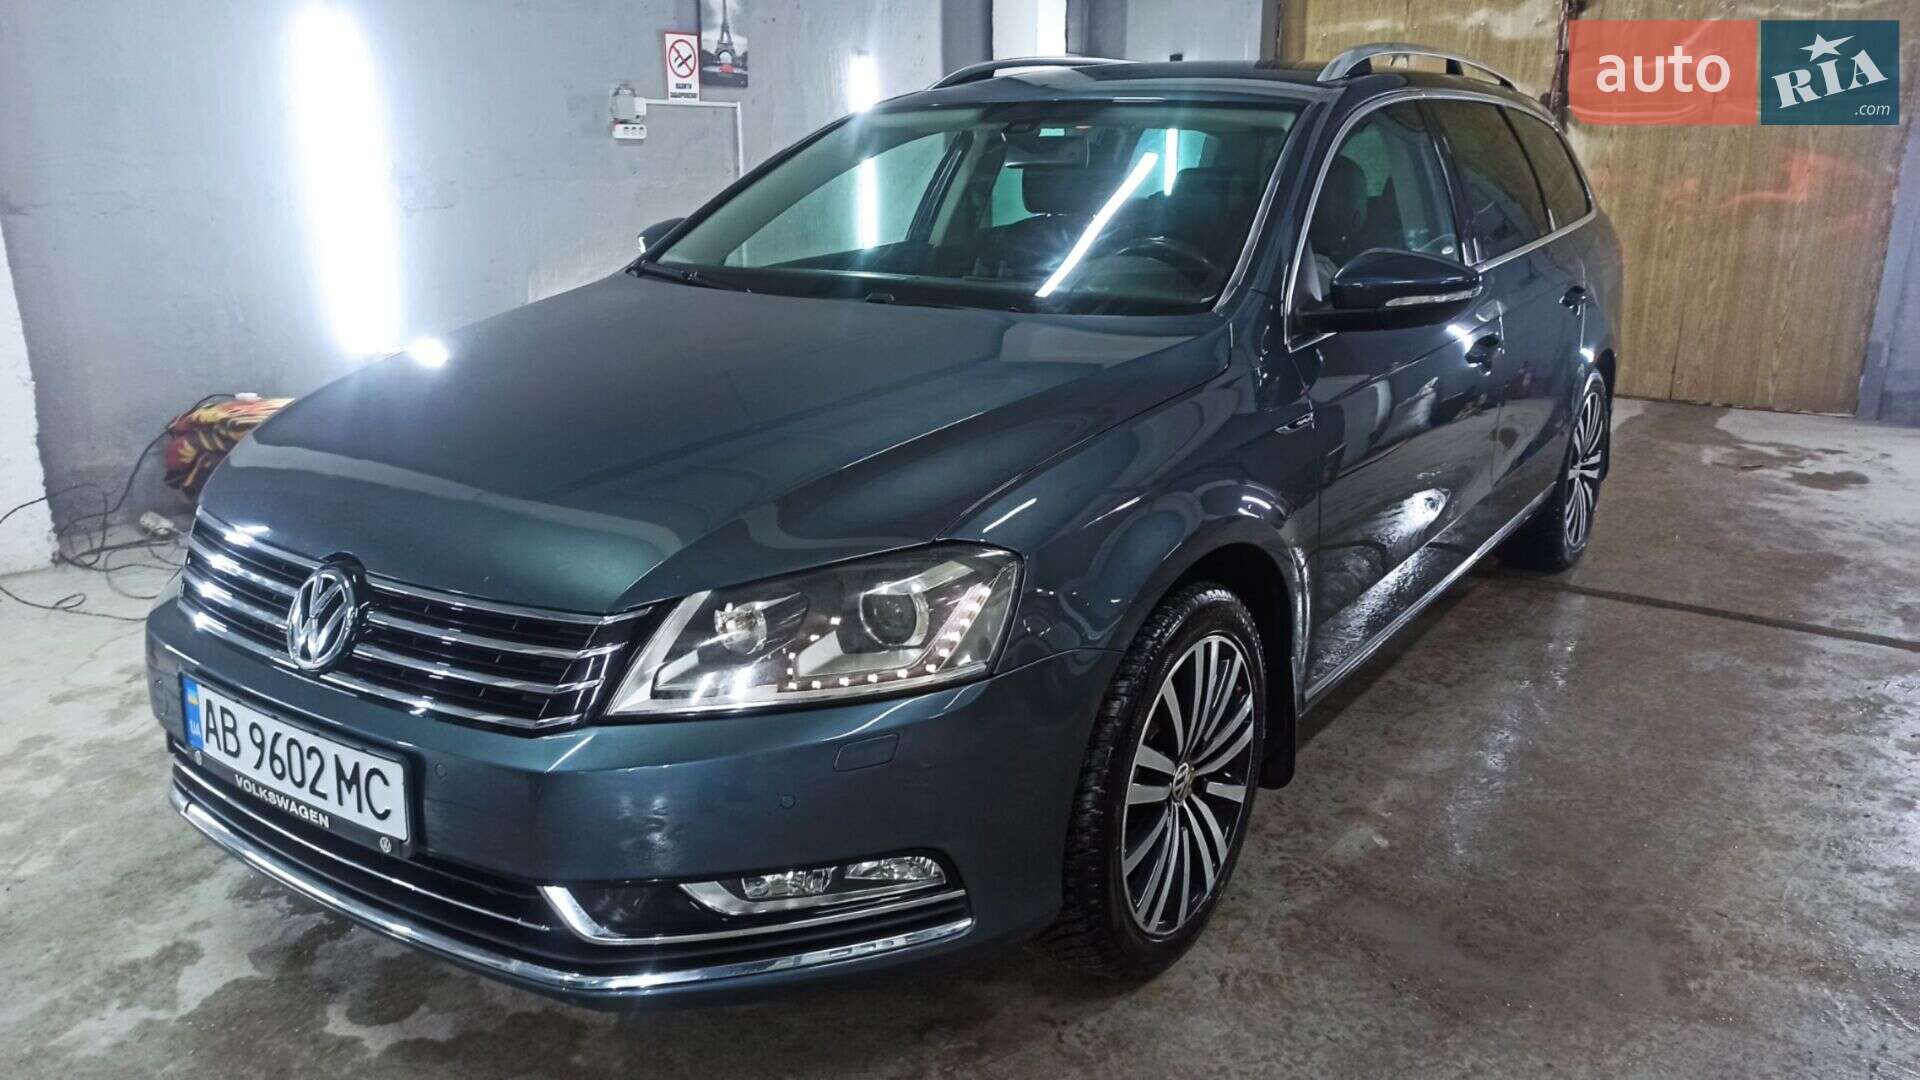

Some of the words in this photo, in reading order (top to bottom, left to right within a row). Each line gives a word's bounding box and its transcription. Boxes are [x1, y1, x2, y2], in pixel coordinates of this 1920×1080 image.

[205, 698, 242, 761] AB
[248, 721, 328, 801] 9602
[334, 753, 392, 821] MC
[233, 774, 331, 829] VOLKSWAGEN
